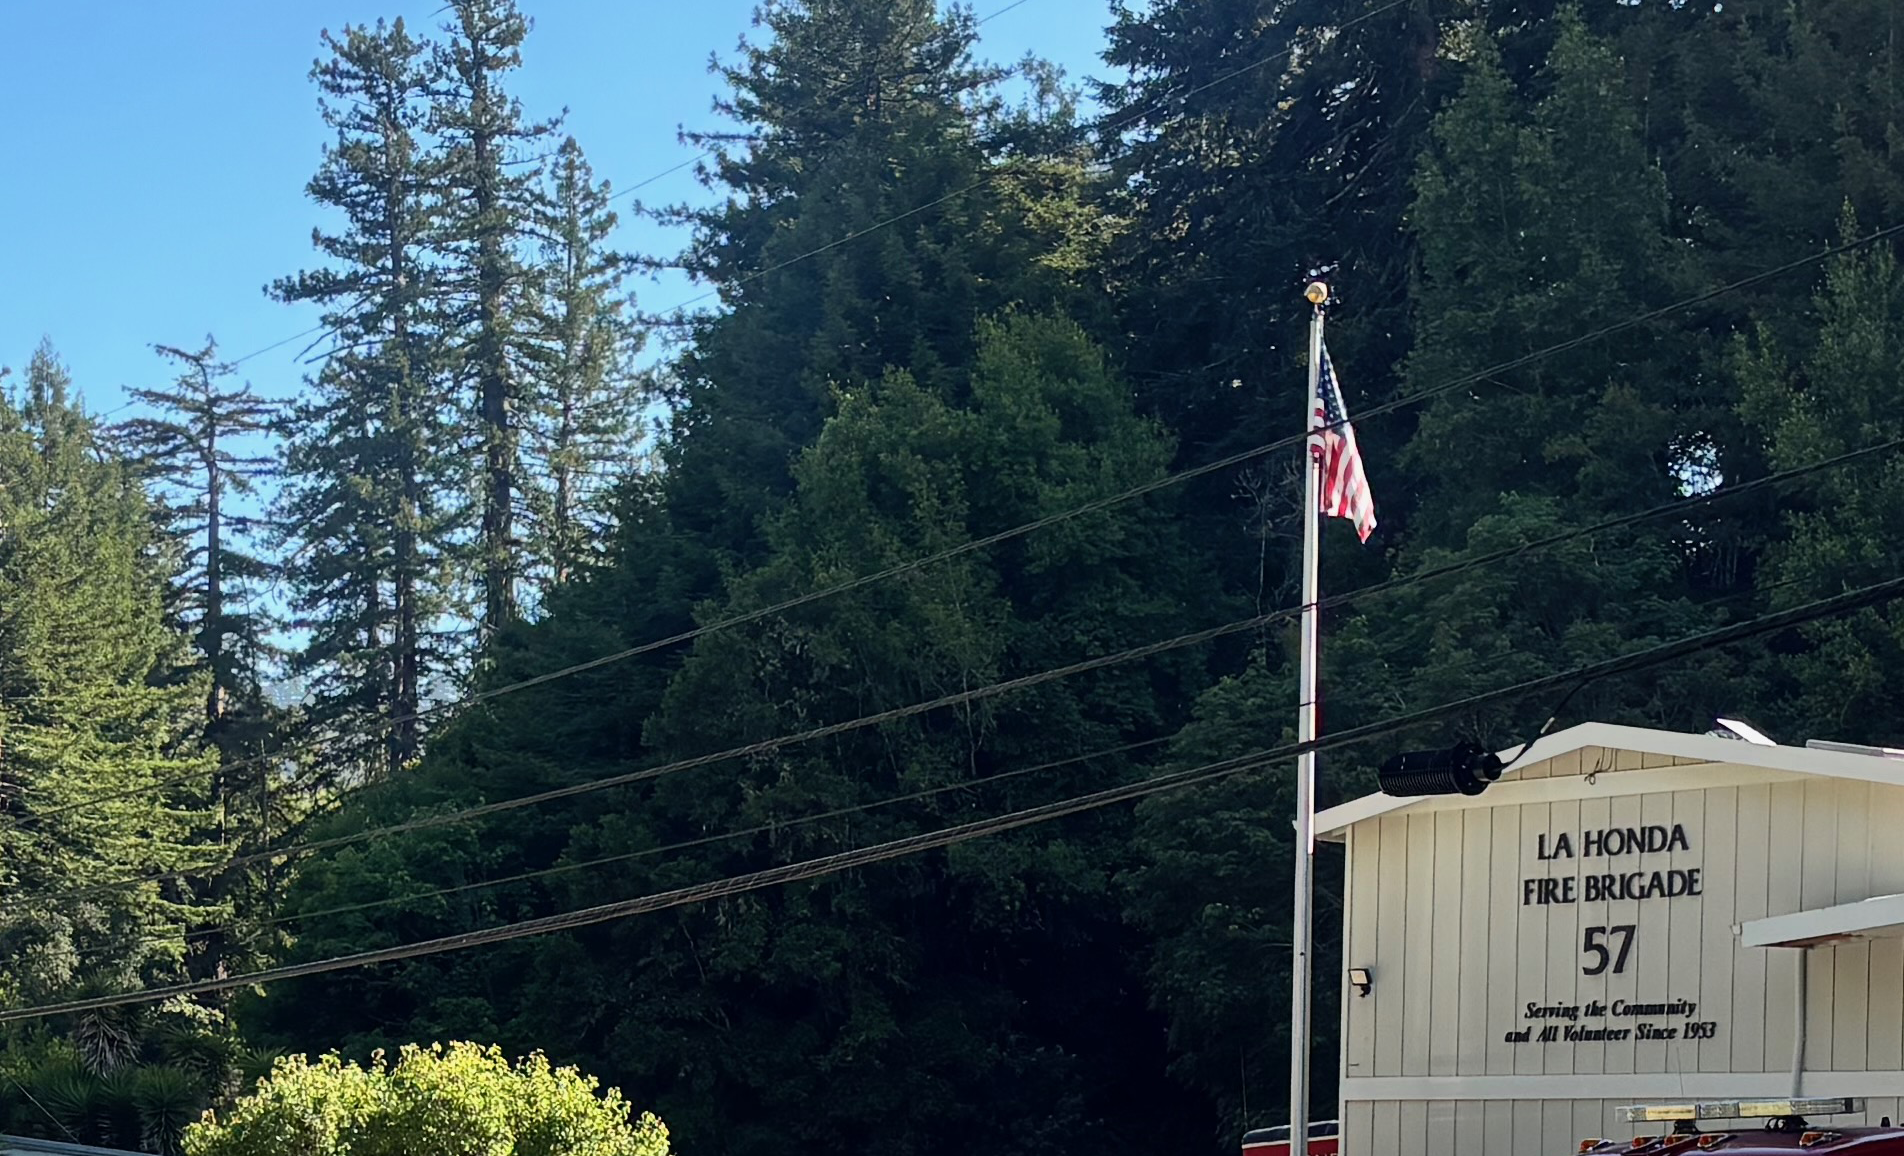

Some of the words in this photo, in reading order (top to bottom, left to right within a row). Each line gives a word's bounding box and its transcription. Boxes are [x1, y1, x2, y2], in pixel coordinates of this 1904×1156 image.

[1537, 832, 1574, 860] LA
[1583, 823, 1690, 858] HONDA
[1523, 876, 1577, 906] FIRE
[1584, 868, 1703, 902] BRIGADE
[1582, 924, 1637, 976] 57
[1524, 1002, 1580, 1021] Serving
[1584, 1000, 1607, 1017] the
[1611, 998, 1697, 1018] Community
[1505, 1026, 1532, 1043] and
[1537, 1025, 1558, 1042] All
[1563, 1024, 1631, 1042] Volunteer
[1635, 1023, 1677, 1040] Since
[1682, 1021, 1717, 1040] 1953
